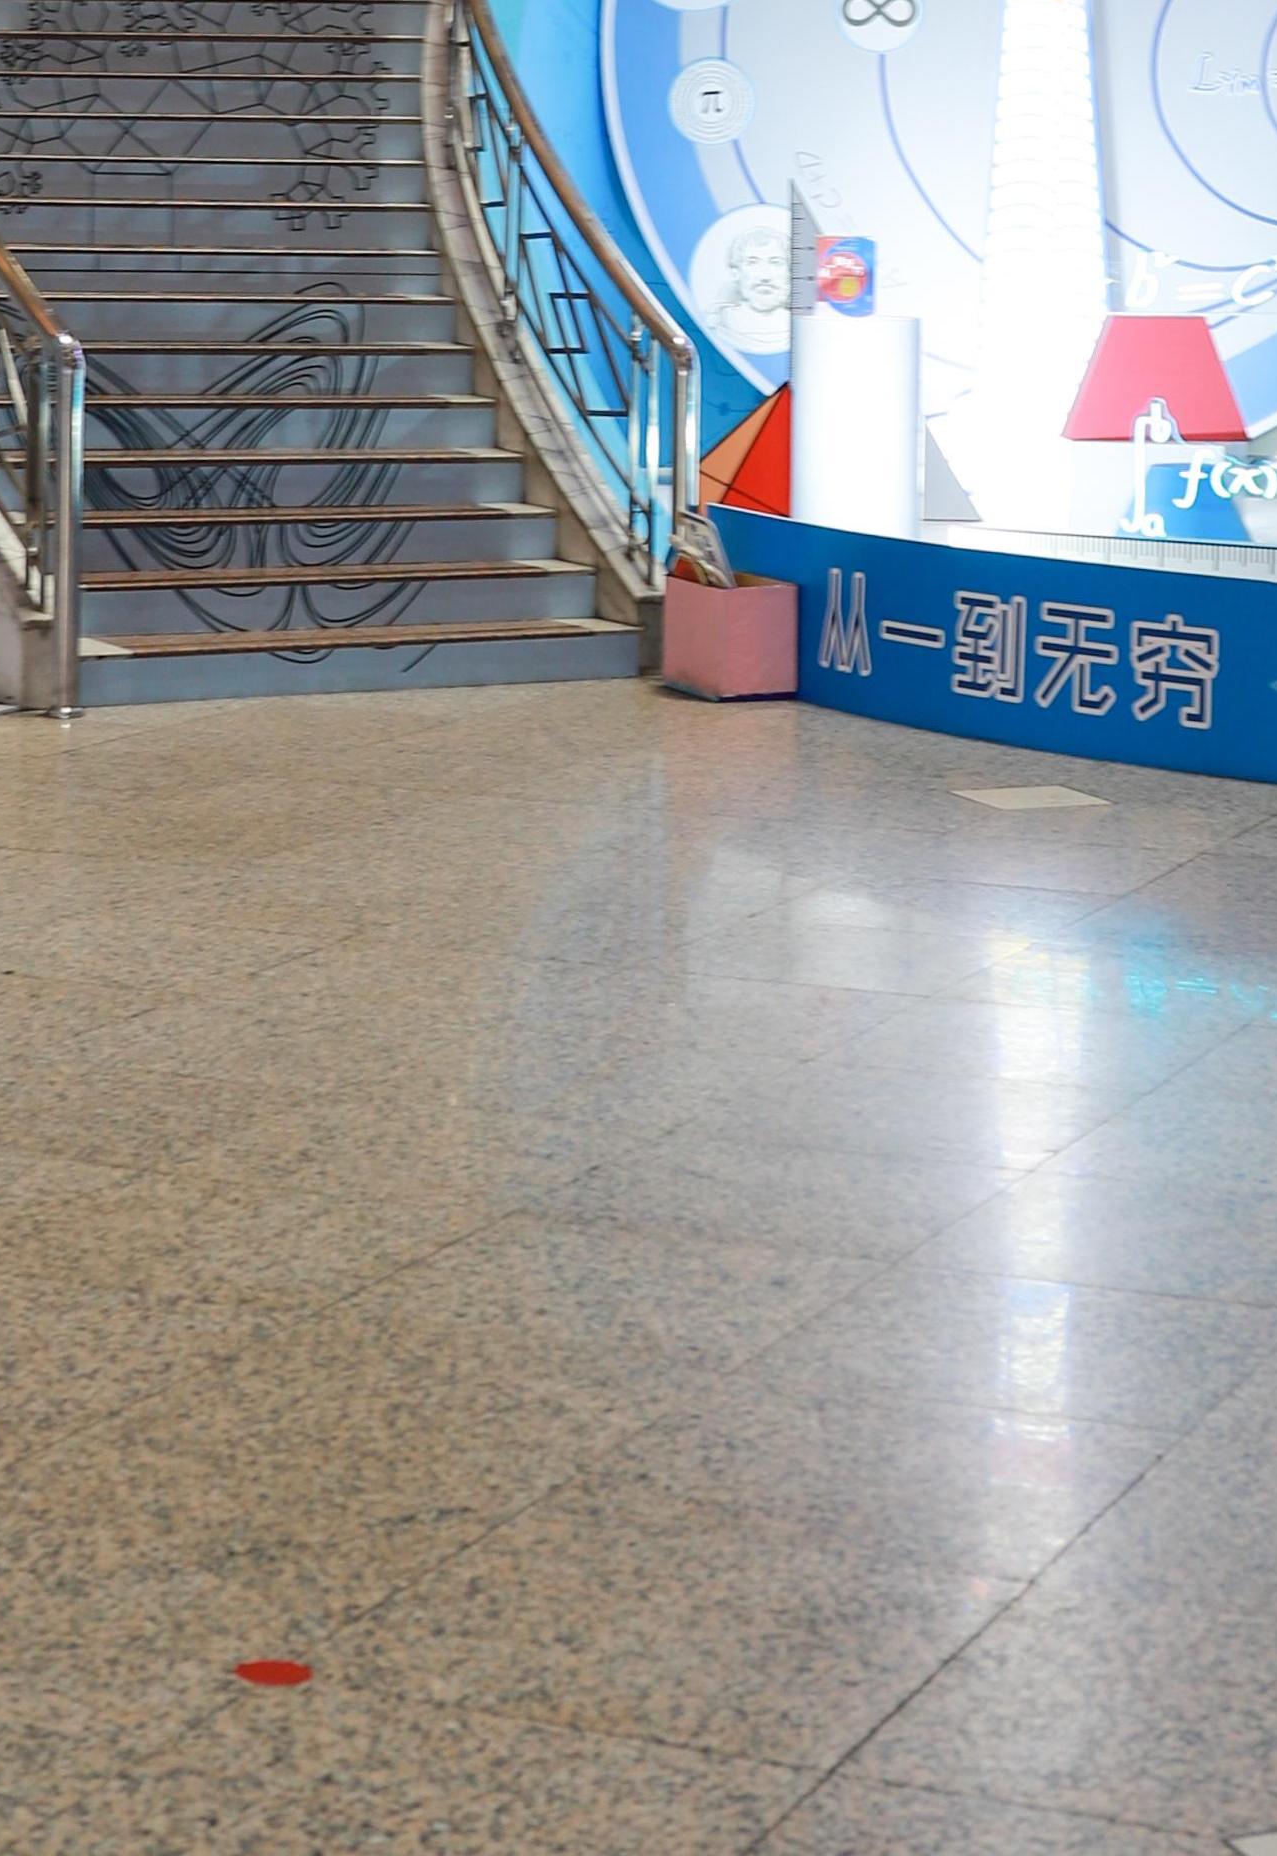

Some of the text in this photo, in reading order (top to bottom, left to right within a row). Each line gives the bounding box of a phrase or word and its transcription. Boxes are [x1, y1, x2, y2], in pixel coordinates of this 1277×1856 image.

[818, 567, 1220, 730] 从一到无穷
